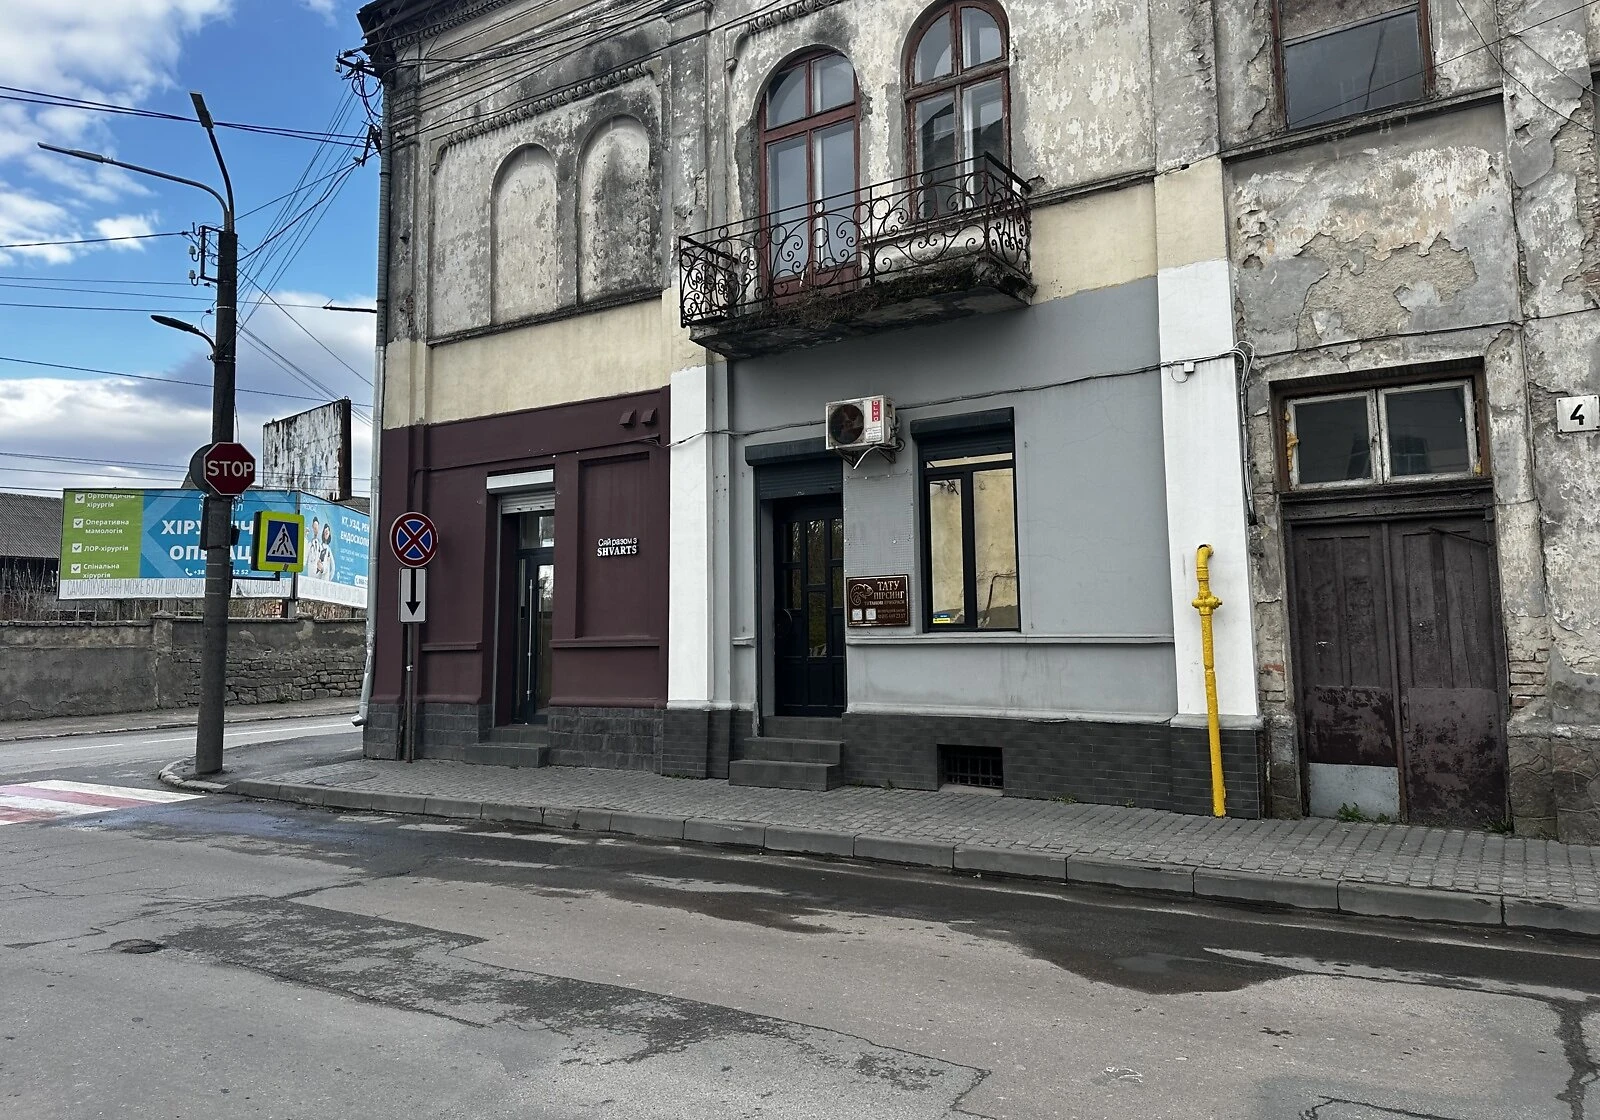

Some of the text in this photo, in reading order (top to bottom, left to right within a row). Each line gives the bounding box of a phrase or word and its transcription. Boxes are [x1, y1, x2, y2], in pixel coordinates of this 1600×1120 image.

[1570, 404, 1585, 426] 4
[207, 460, 254, 477] STOP
[612, 538, 632, 547] разом
[597, 545, 637, 557] SHVARTS
[877, 580, 900, 591] ТАТУ
[873, 591, 905, 600] ПІРСИНГ
